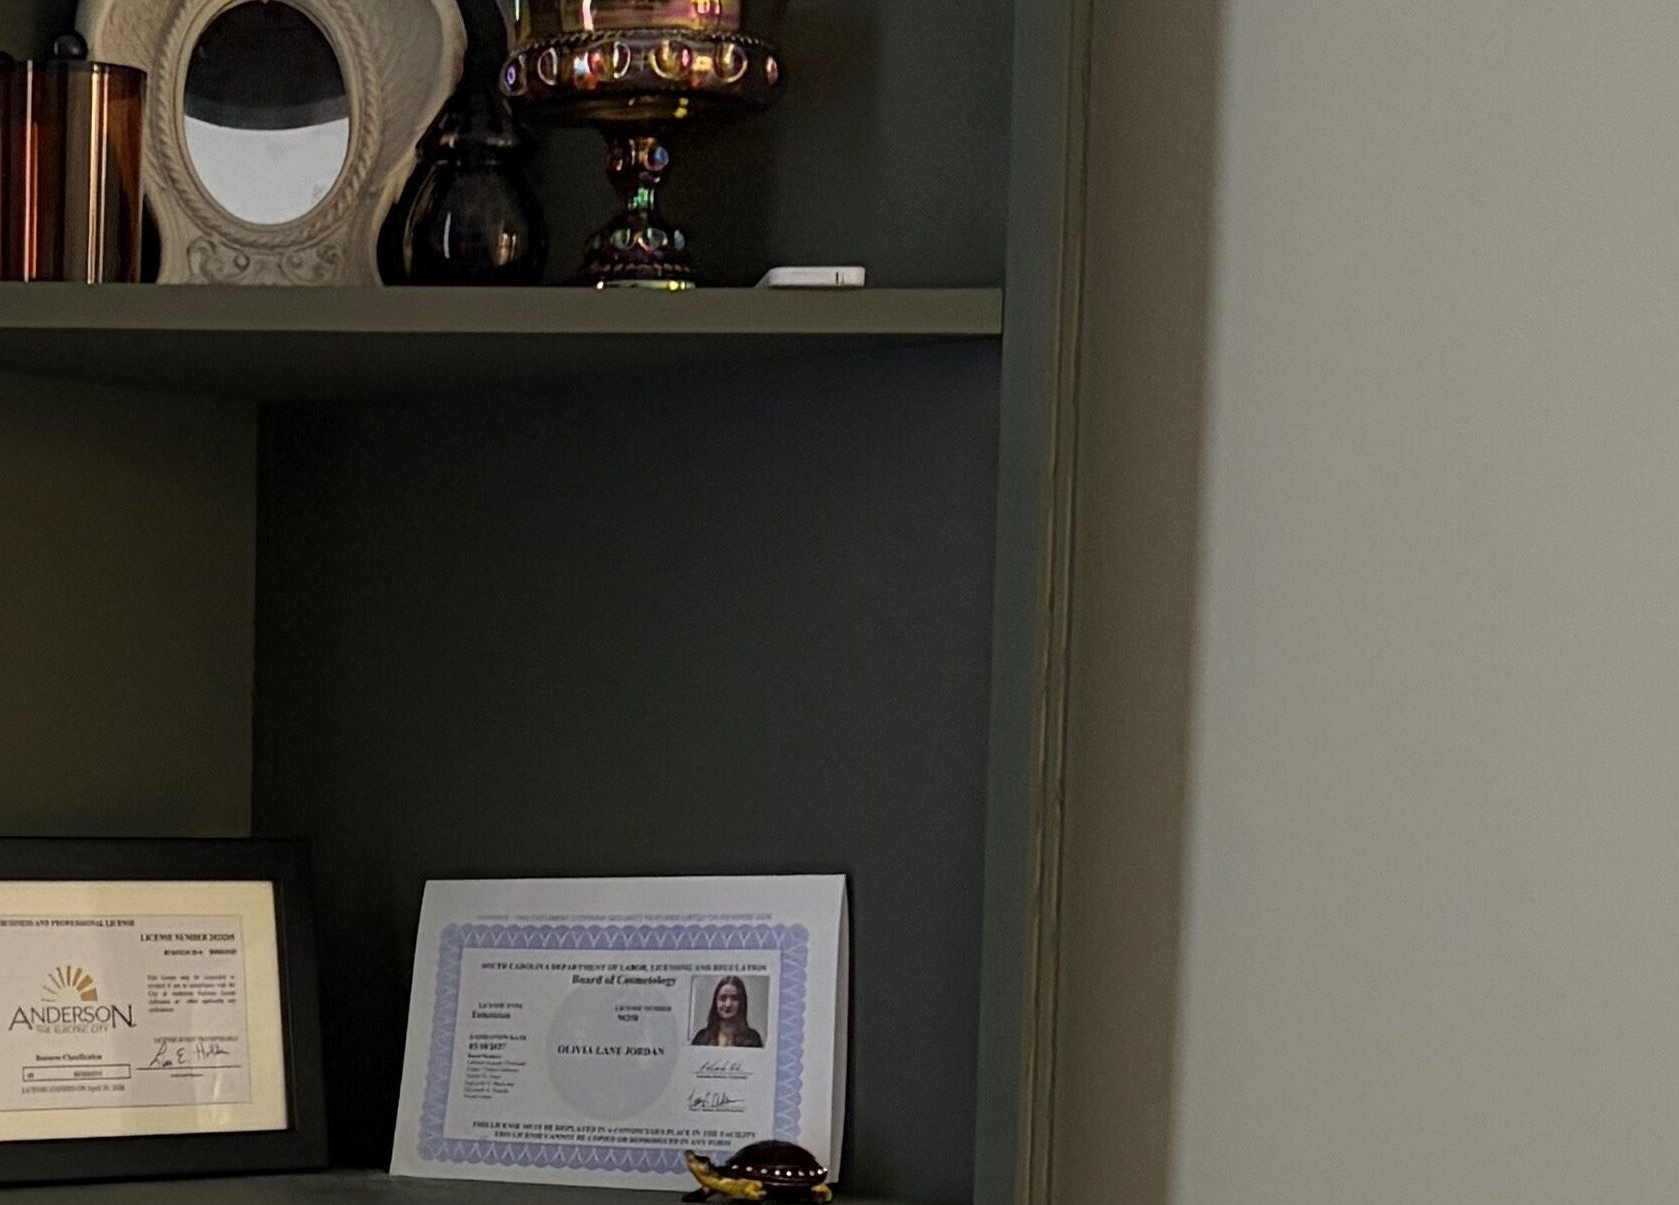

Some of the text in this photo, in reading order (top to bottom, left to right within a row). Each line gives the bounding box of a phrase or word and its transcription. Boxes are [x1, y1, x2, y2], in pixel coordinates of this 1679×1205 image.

[139, 933, 172, 943] LICENSE
[174, 933, 207, 943] NUMBER
[571, 974, 677, 987] Board of Cosmetology
[8, 1004, 134, 1032] ANDERSON
[557, 1045, 665, 1056] OLIVIA LANE JORDAN
